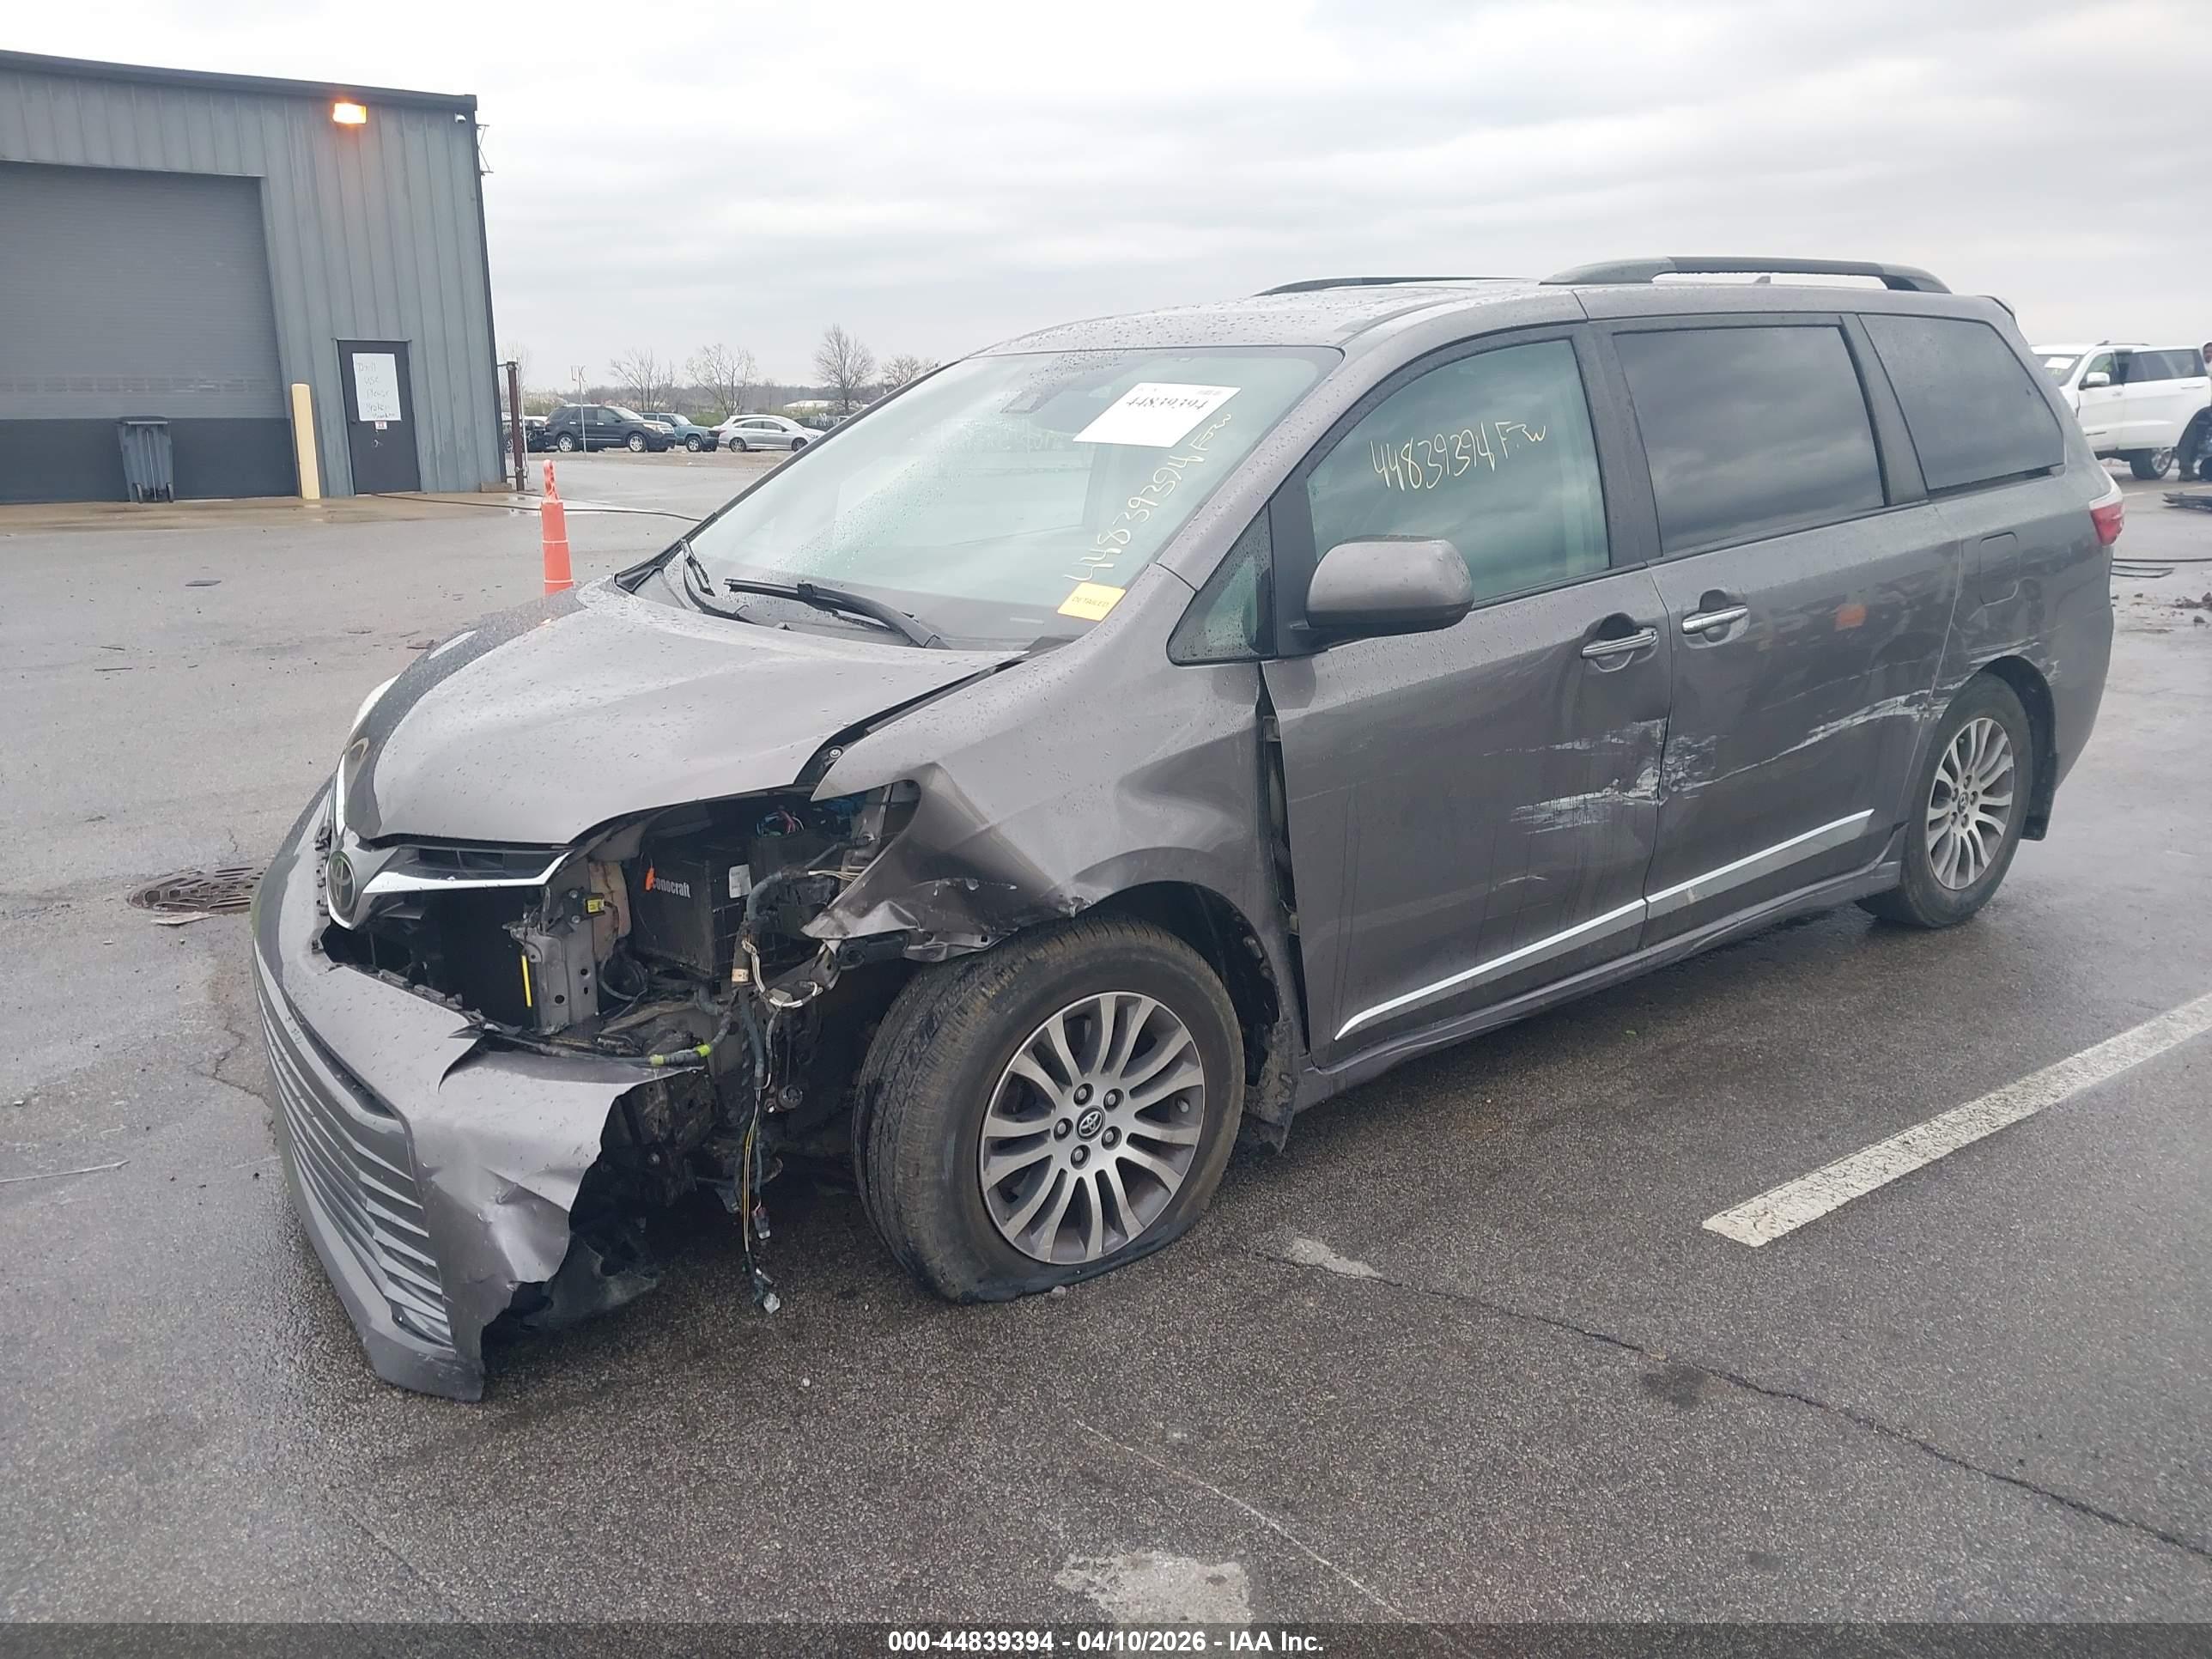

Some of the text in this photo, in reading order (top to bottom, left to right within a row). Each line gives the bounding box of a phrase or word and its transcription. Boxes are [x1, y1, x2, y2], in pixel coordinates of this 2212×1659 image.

[1370, 421, 1496, 492] 44839394
[1063, 454, 1206, 581] 44839394
[650, 877, 691, 899] conocraft
